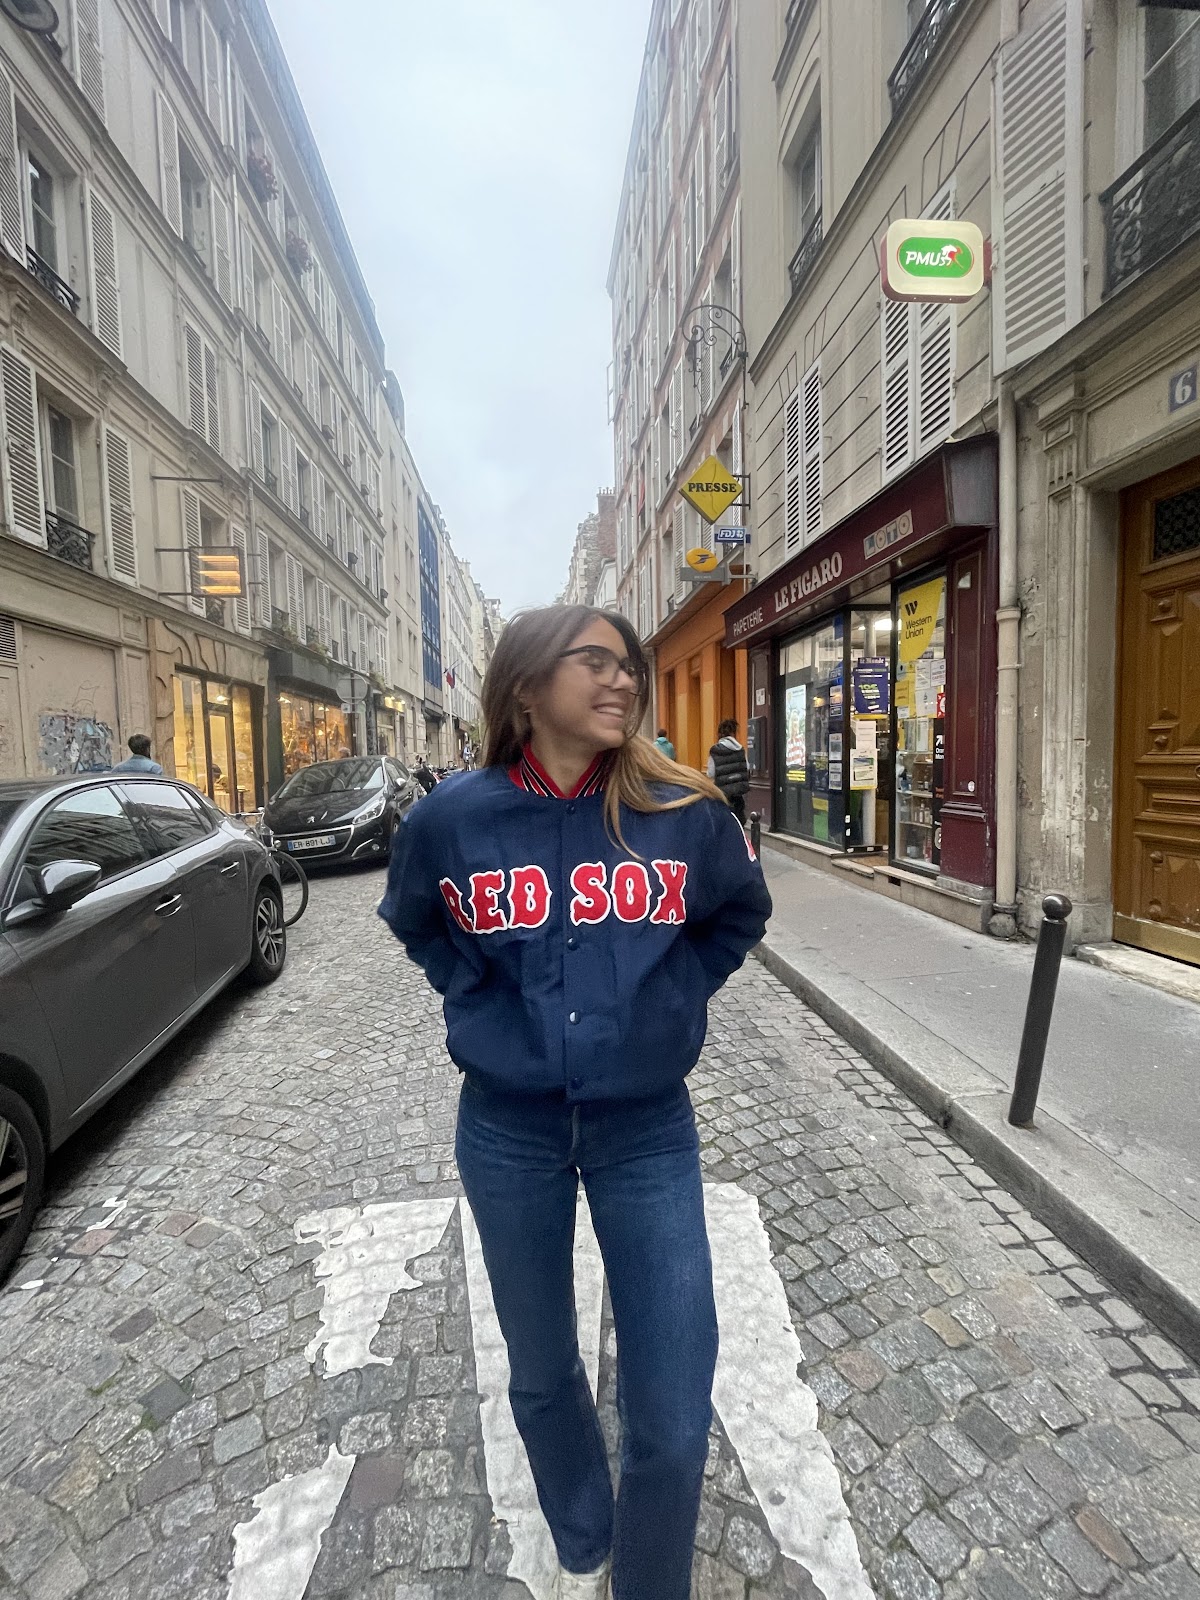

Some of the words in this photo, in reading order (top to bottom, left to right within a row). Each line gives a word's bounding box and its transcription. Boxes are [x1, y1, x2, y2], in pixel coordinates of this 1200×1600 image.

[905, 250, 942, 267] PMU
[1174, 371, 1193, 405] 6
[687, 482, 738, 493] PRESSE
[720, 529, 736, 538] FDJ
[864, 514, 911, 558] LOTO
[774, 587, 789, 613] LE
[789, 551, 842, 604] FIGARO
[733, 607, 764, 637] PAPETERIE
[905, 615, 932, 630] Western
[905, 627, 924, 640] Union
[570, 859, 688, 927] SOX
